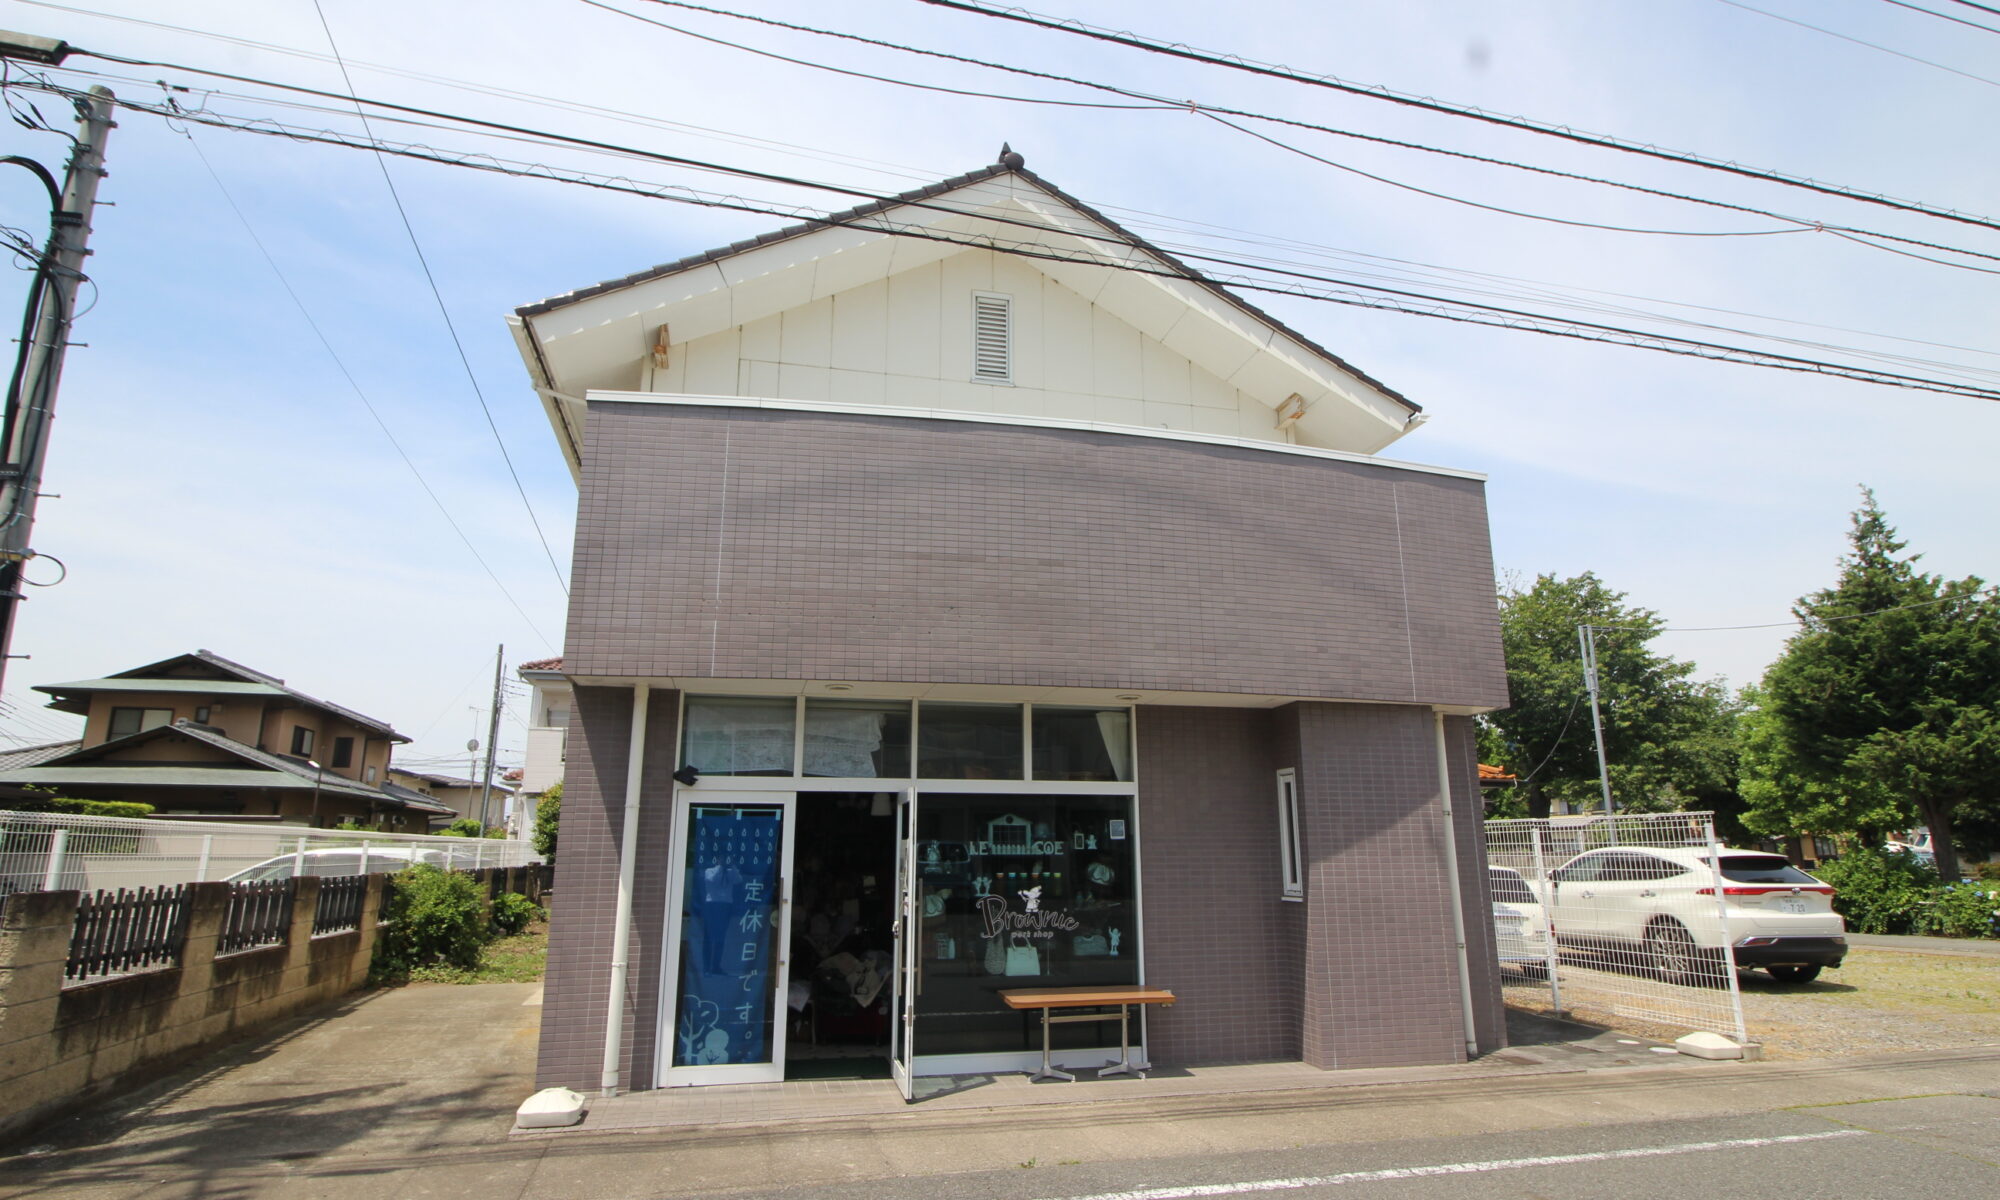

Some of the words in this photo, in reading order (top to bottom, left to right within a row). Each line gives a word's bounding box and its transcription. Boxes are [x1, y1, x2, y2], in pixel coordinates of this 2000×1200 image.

[976, 894, 1080, 939] Brownie
[1033, 930, 1054, 939] shop
[734, 879, 764, 1040] 定休日です。
